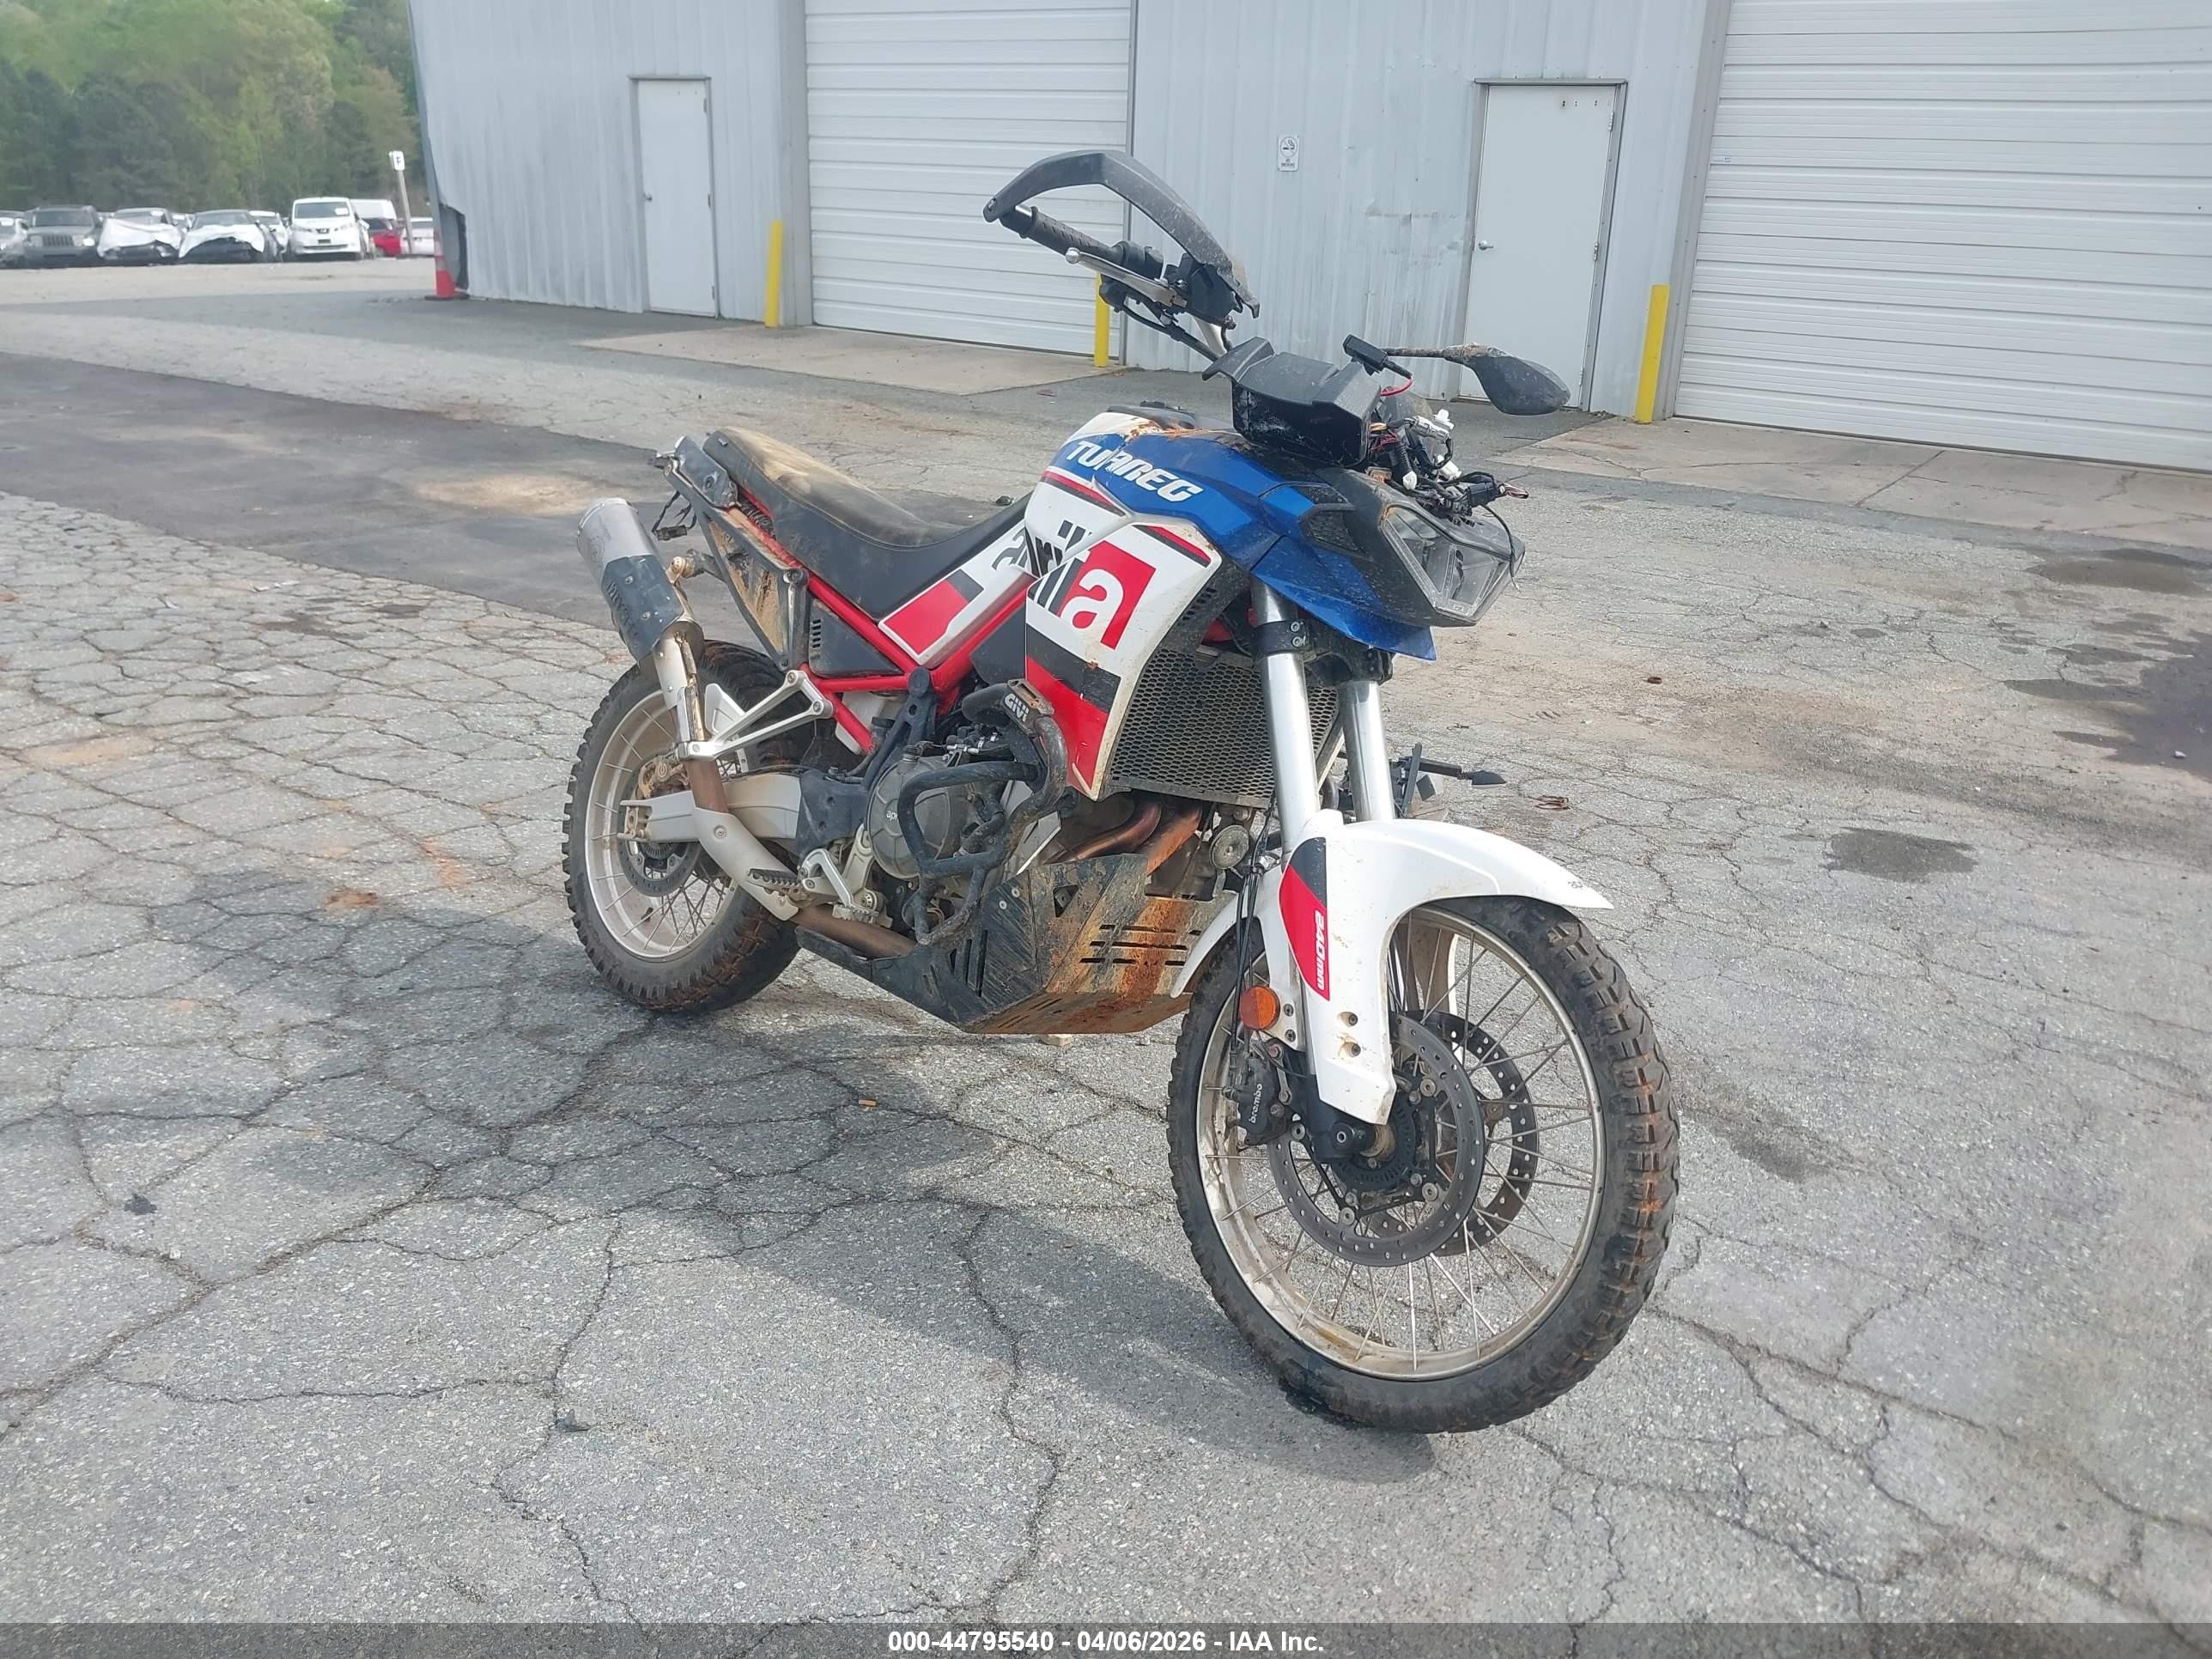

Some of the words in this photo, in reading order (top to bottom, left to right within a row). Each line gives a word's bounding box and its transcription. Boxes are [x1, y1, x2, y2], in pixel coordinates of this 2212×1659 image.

[1005, 693, 1030, 722] GIVI
[1315, 909, 1326, 991] 240mm
[1248, 1083, 1262, 1124] brembo
